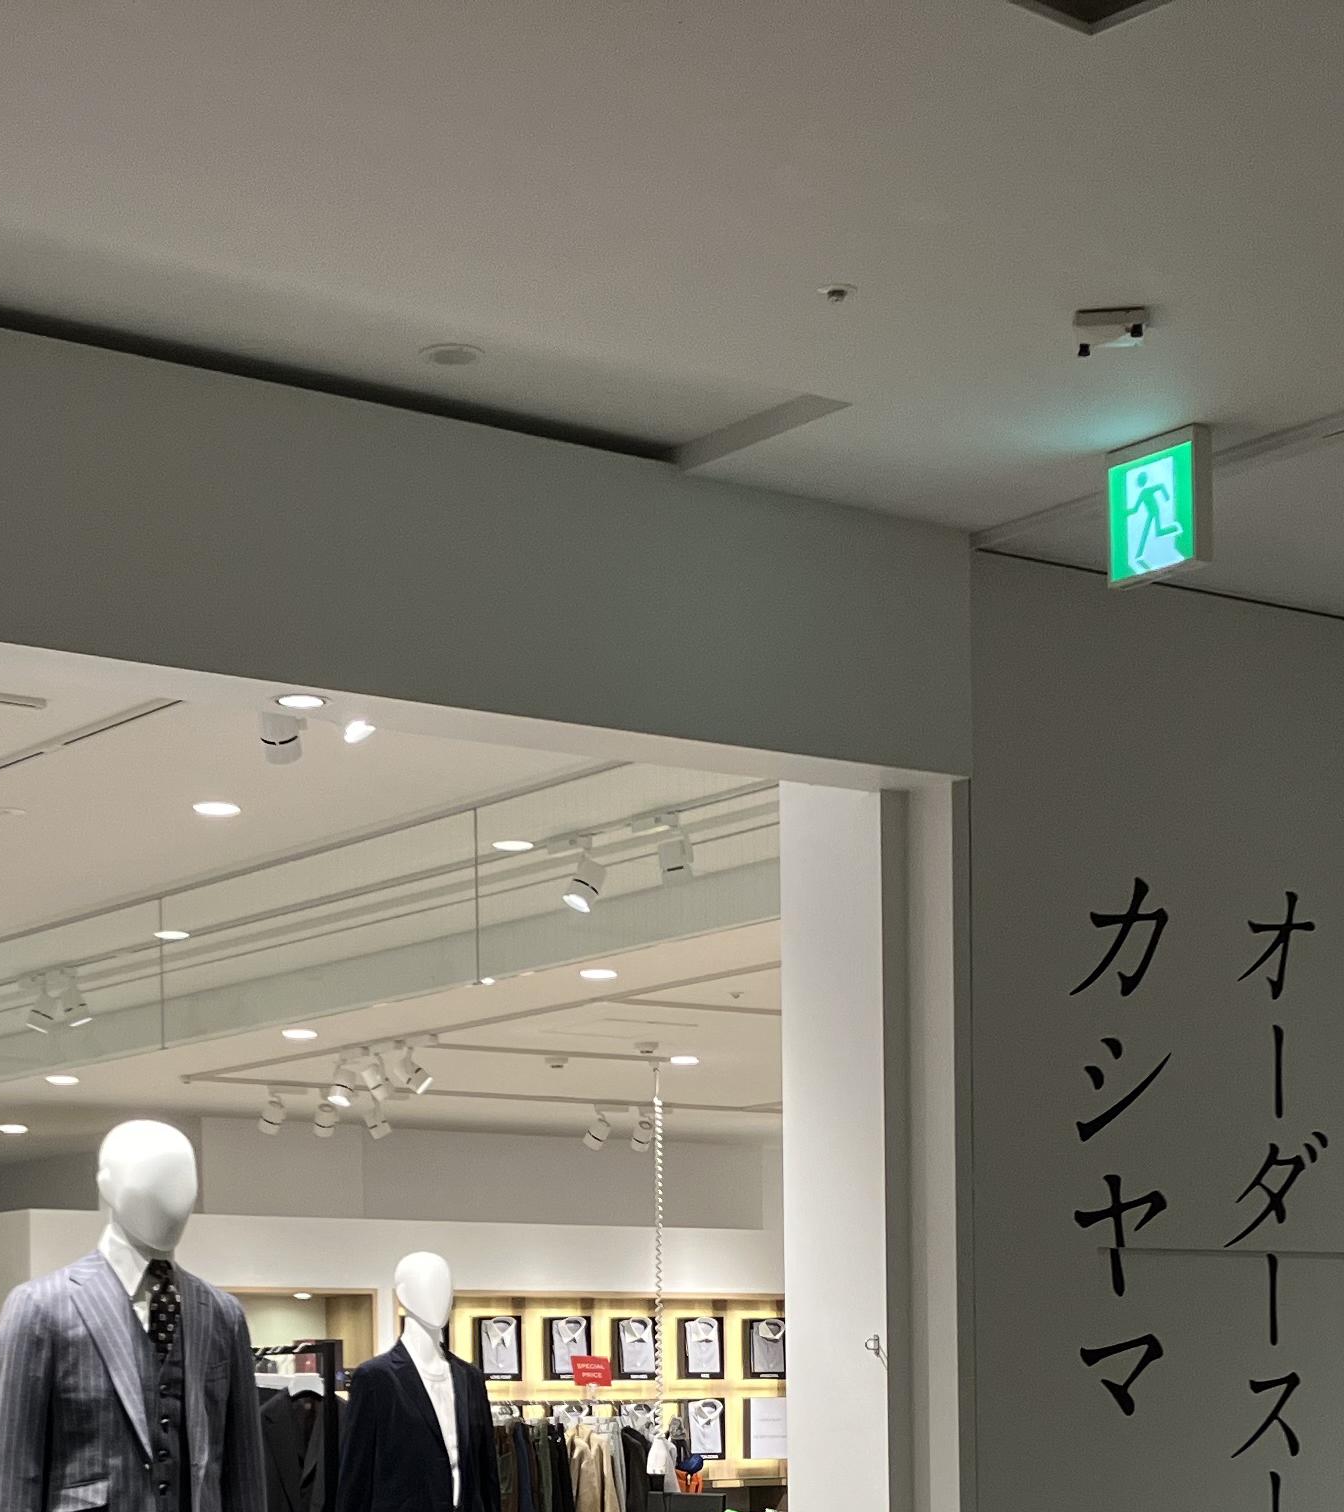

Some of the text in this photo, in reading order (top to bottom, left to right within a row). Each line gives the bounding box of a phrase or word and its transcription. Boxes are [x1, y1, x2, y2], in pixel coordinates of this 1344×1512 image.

[1068, 877, 1172, 1416] カシヤマ
[576, 1362, 606, 1371] SPECIAL
